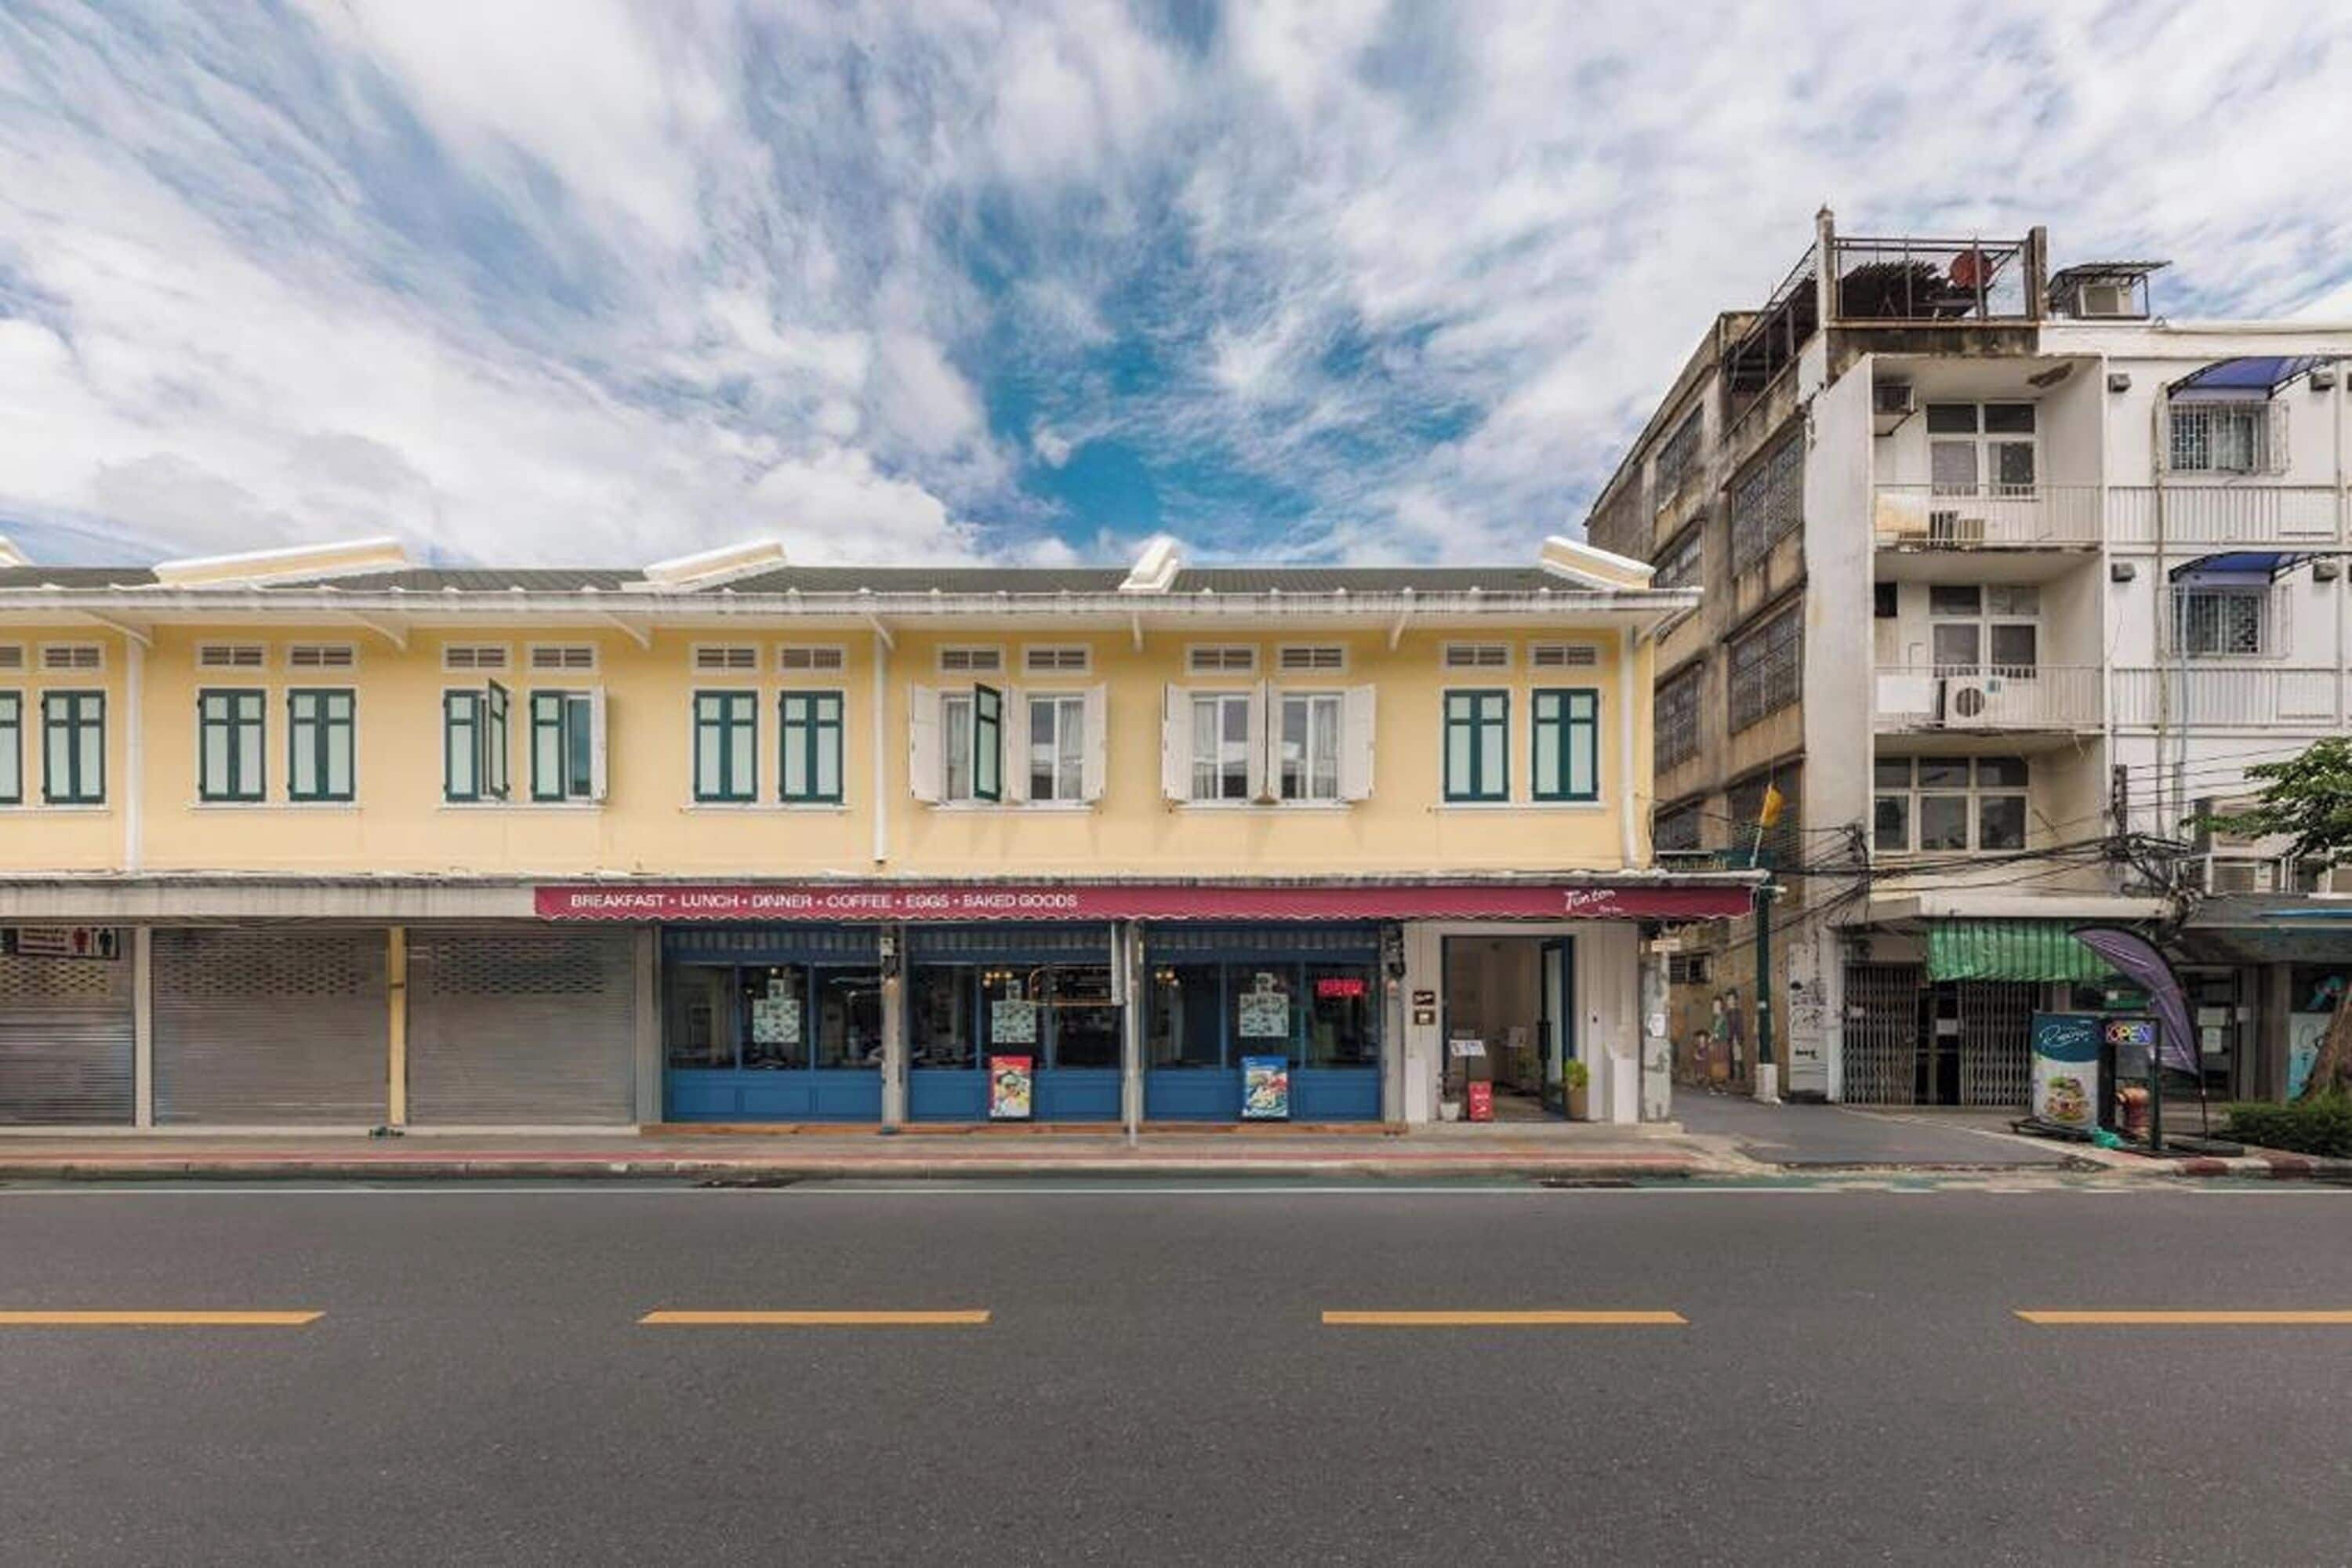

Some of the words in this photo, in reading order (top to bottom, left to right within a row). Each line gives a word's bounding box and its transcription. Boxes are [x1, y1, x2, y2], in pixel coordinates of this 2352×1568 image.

[571, 894, 665, 908] BREAKFAST
[681, 894, 739, 908] LUNCH
[752, 894, 812, 908] DINNER
[826, 894, 892, 908] COFFEE
[906, 894, 949, 908] EGGS
[963, 894, 1016, 908] BAKED
[1019, 894, 1078, 908] GOODS
[2107, 1023, 2153, 1044] OPEN
